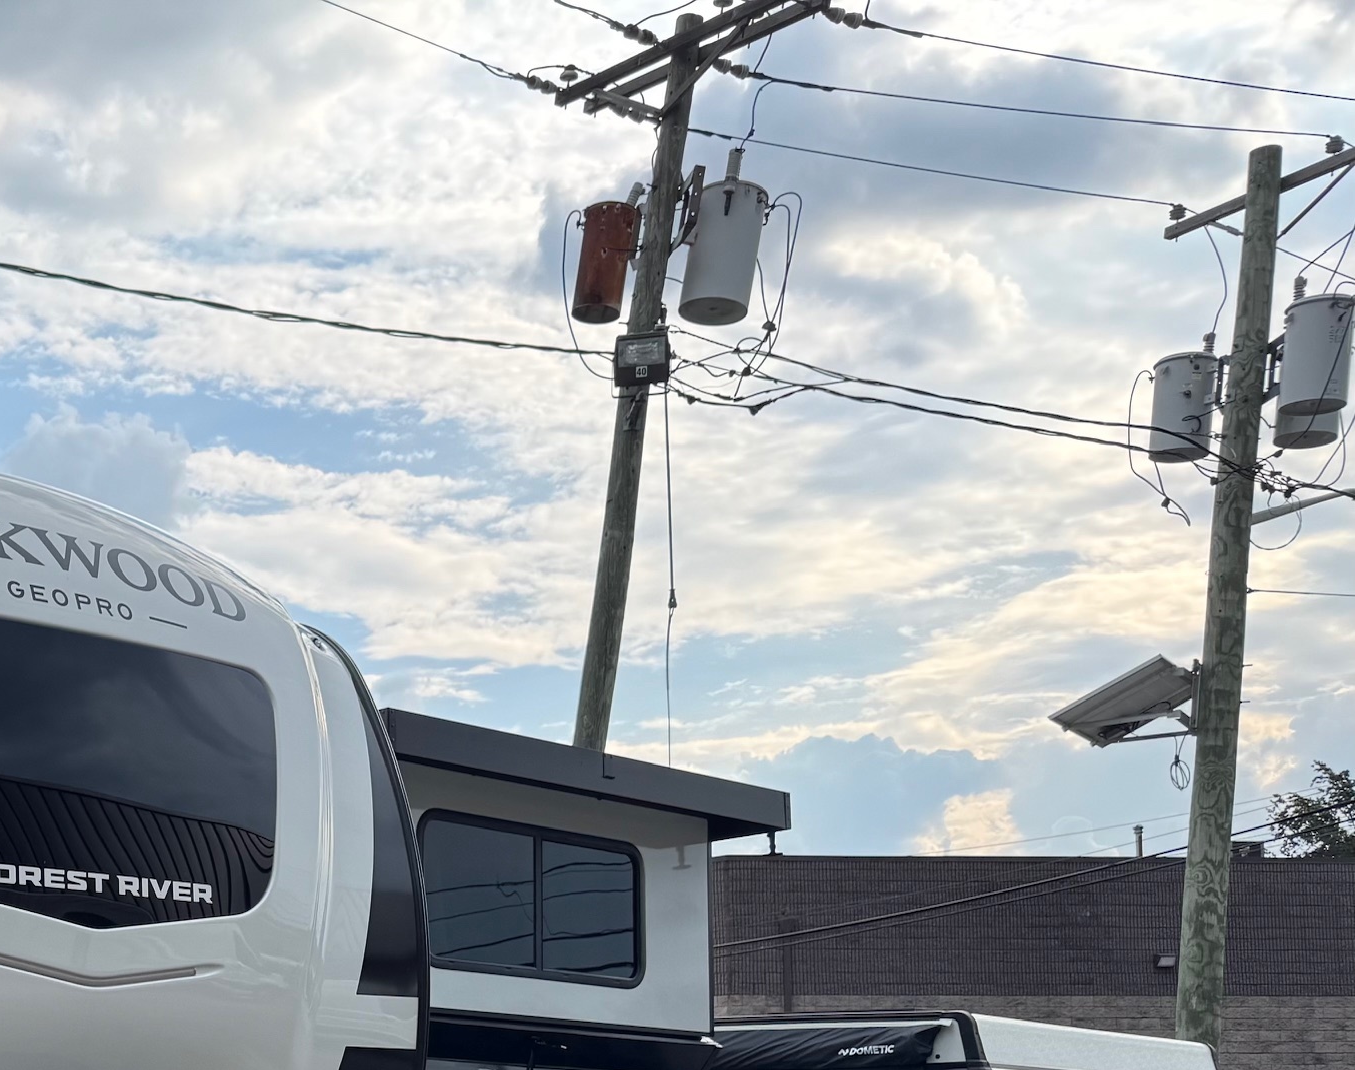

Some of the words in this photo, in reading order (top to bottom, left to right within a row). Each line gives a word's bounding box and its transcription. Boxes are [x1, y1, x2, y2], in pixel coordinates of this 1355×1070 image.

[636, 367, 646, 376] 40
[7, 580, 134, 621] GEOPRO
[116, 875, 213, 905] RIVER
[848, 1044, 895, 1056] DOMETIC
